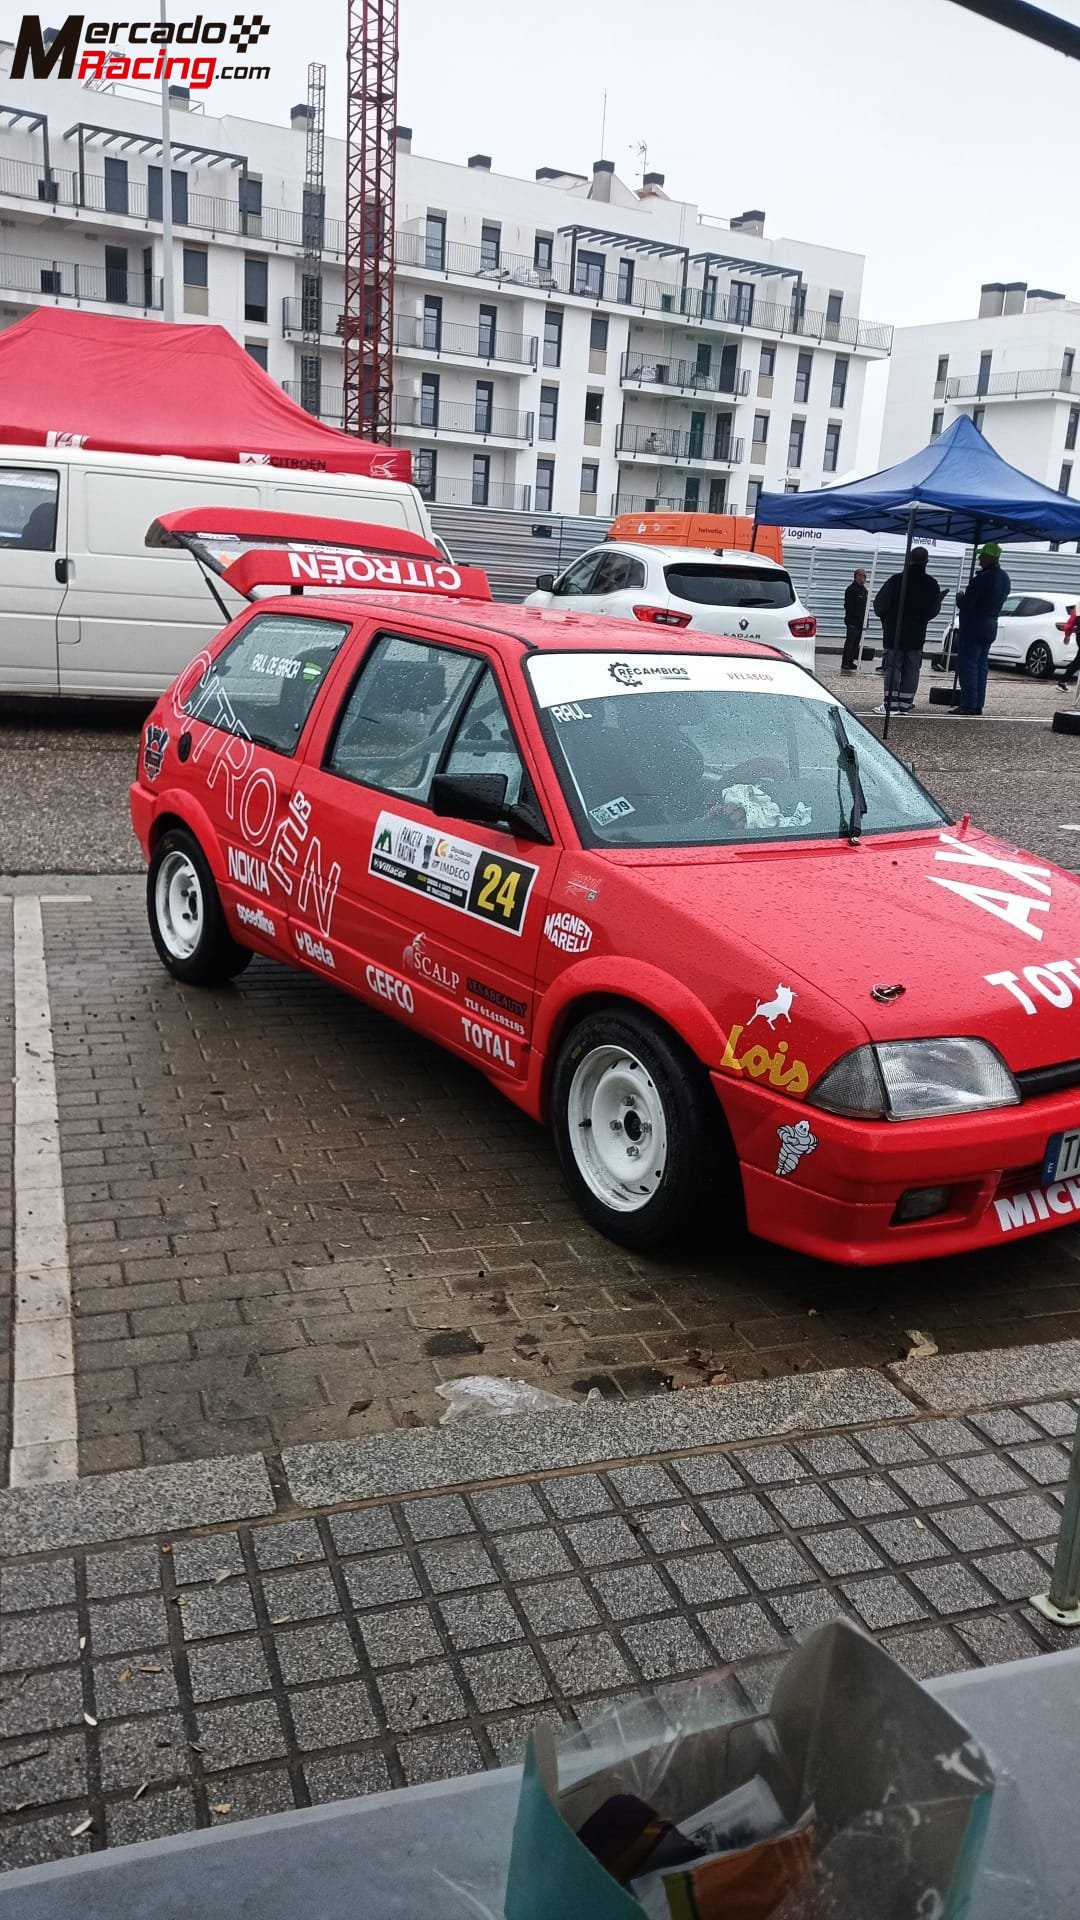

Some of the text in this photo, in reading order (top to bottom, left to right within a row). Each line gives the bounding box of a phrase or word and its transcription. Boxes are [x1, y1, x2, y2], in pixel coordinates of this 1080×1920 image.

[288, 552, 462, 590] CITROËN
[617, 667, 773, 681] RECAMBIOS VELASCO
[551, 703, 593, 722] RAUL
[397, 842, 417, 865] RACING
[401, 826, 423, 848] PANCETA
[228, 846, 270, 896] NOKIA
[379, 861, 407, 879] Villacor
[440, 861, 470, 881] IMDECO
[924, 833, 1052, 942] AX
[477, 863, 521, 918] 24
[236, 903, 275, 937] speedline
[303, 931, 336, 968] Beta
[366, 965, 414, 1013] GEFCO
[414, 952, 460, 989] SCALP
[983, 957, 1080, 1016] TOT
[461, 1016, 516, 1067] TOTAL
[720, 1024, 809, 1093] Lois
[1063, 1134, 1080, 1173] T
